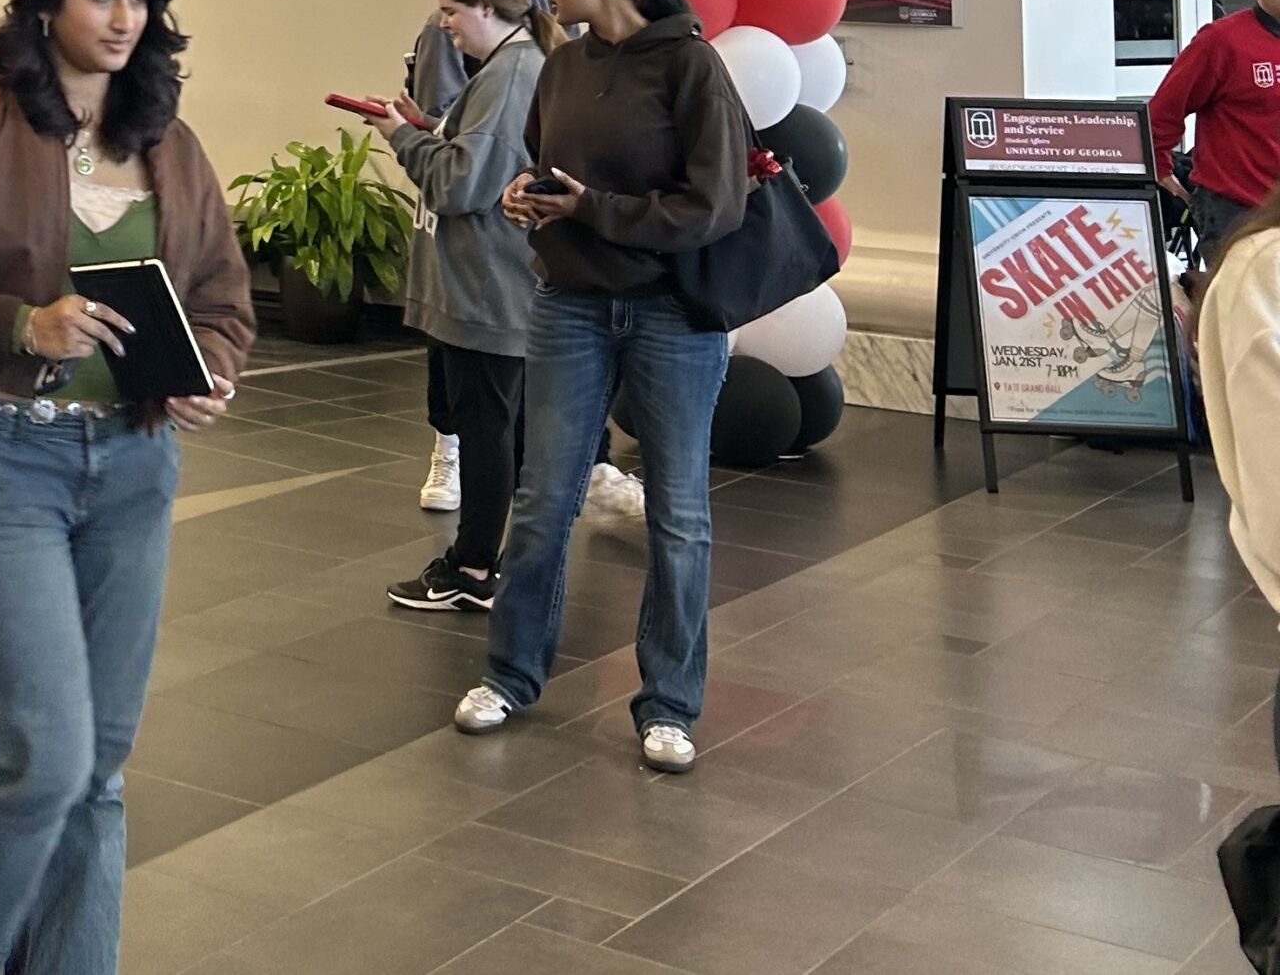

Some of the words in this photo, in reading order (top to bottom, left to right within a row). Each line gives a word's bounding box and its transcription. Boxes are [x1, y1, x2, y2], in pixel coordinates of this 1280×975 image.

[1003, 113, 1072, 125] Engagement,
[1074, 115, 1137, 127] Leadership,
[1004, 125, 1024, 134] and
[1026, 125, 1065, 135] Service
[1005, 147, 1060, 156] UNIVERSITY
[1062, 148, 1075, 156] OF
[1078, 148, 1122, 157] GEORGIA
[979, 204, 1119, 319] SKATE
[1053, 290, 1097, 326] IN
[1082, 248, 1157, 311] TATE
[1019, 356, 1042, 367] 21ST
